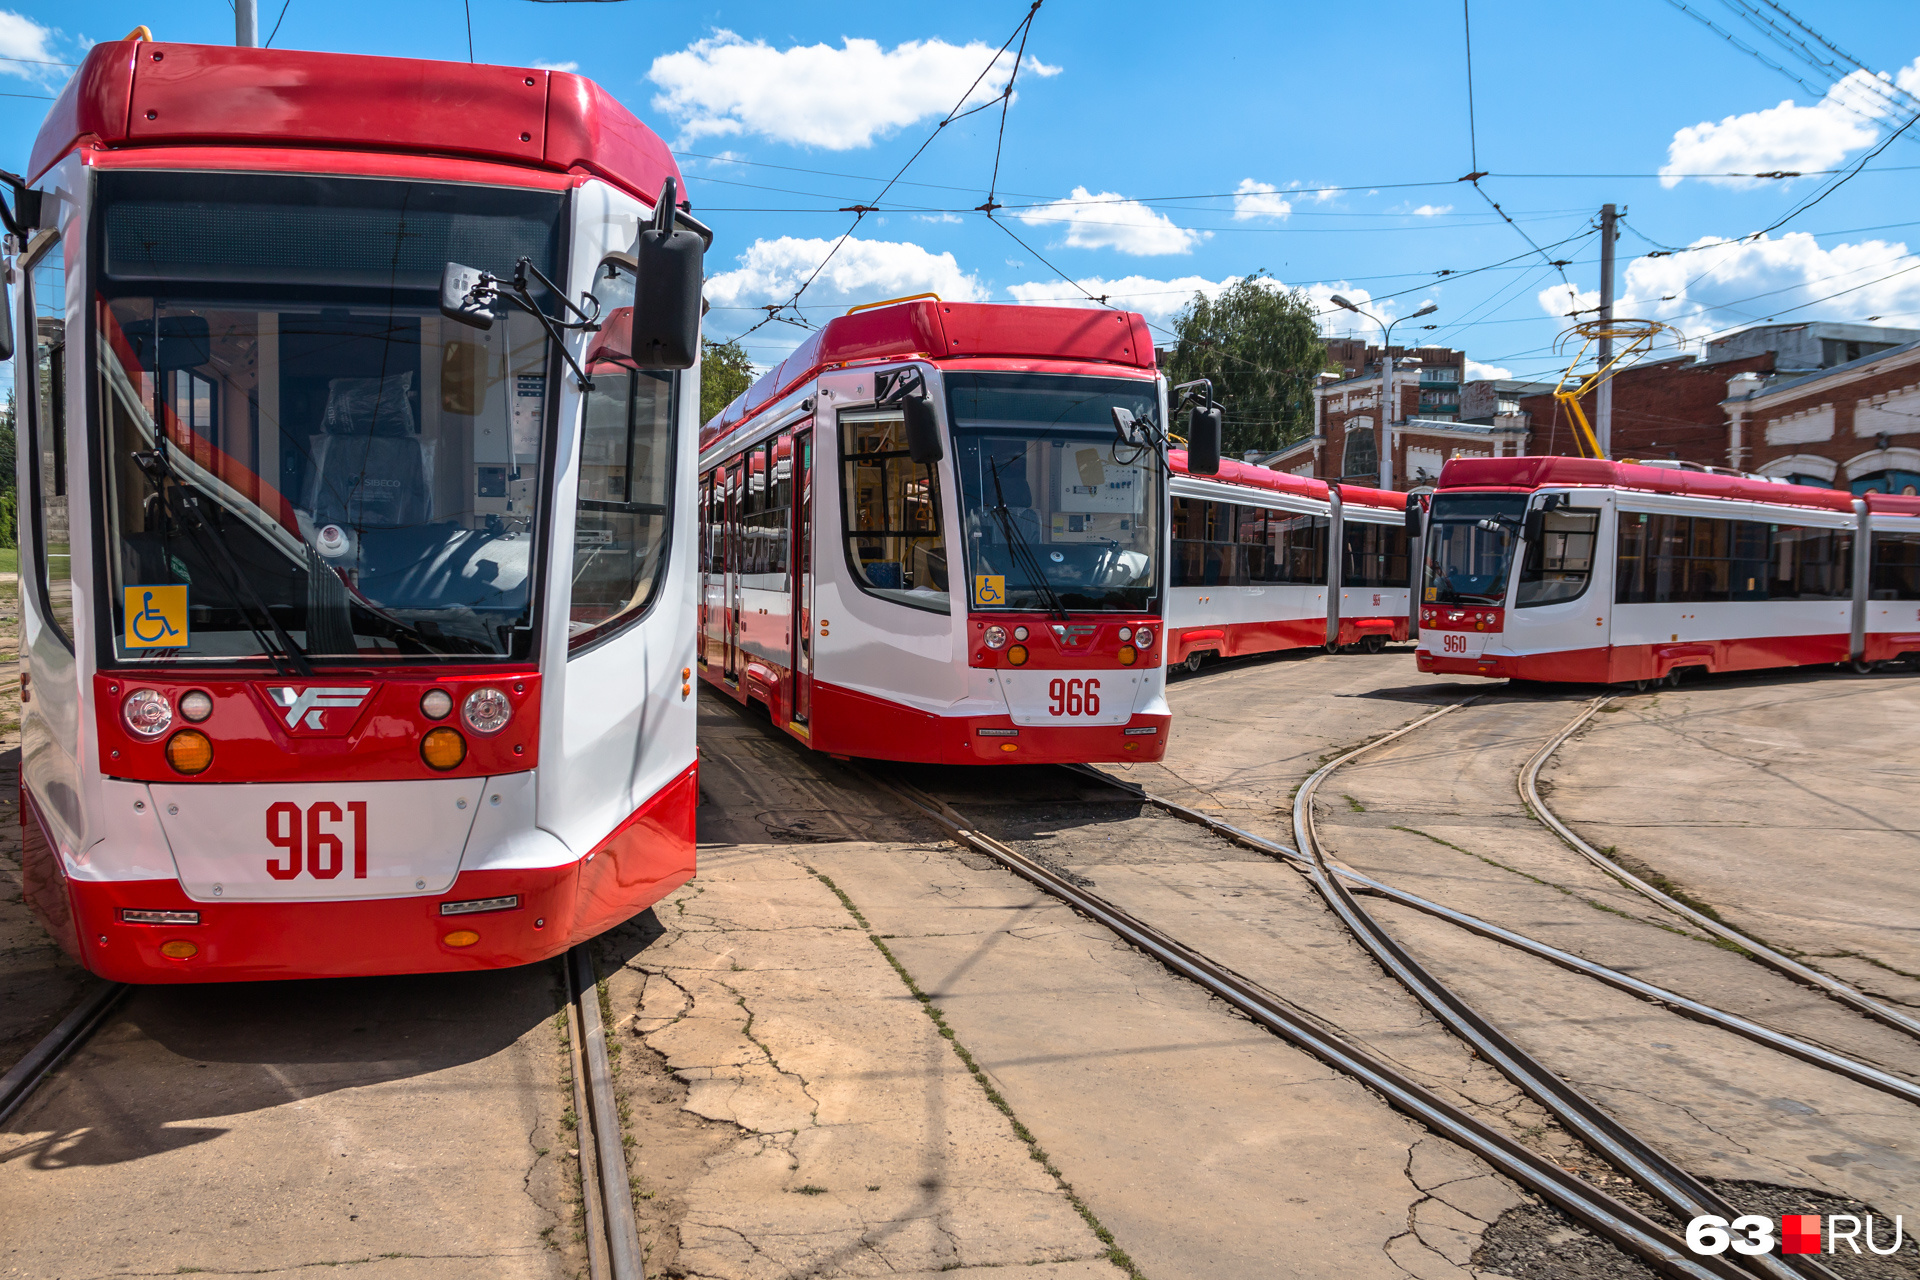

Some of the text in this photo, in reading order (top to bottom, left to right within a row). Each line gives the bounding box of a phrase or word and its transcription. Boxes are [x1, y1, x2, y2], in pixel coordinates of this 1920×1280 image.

[364, 479, 401, 487] SIBECO
[1444, 635, 1466, 653] 960
[1048, 678, 1100, 716] 966
[266, 801, 367, 880] 961
